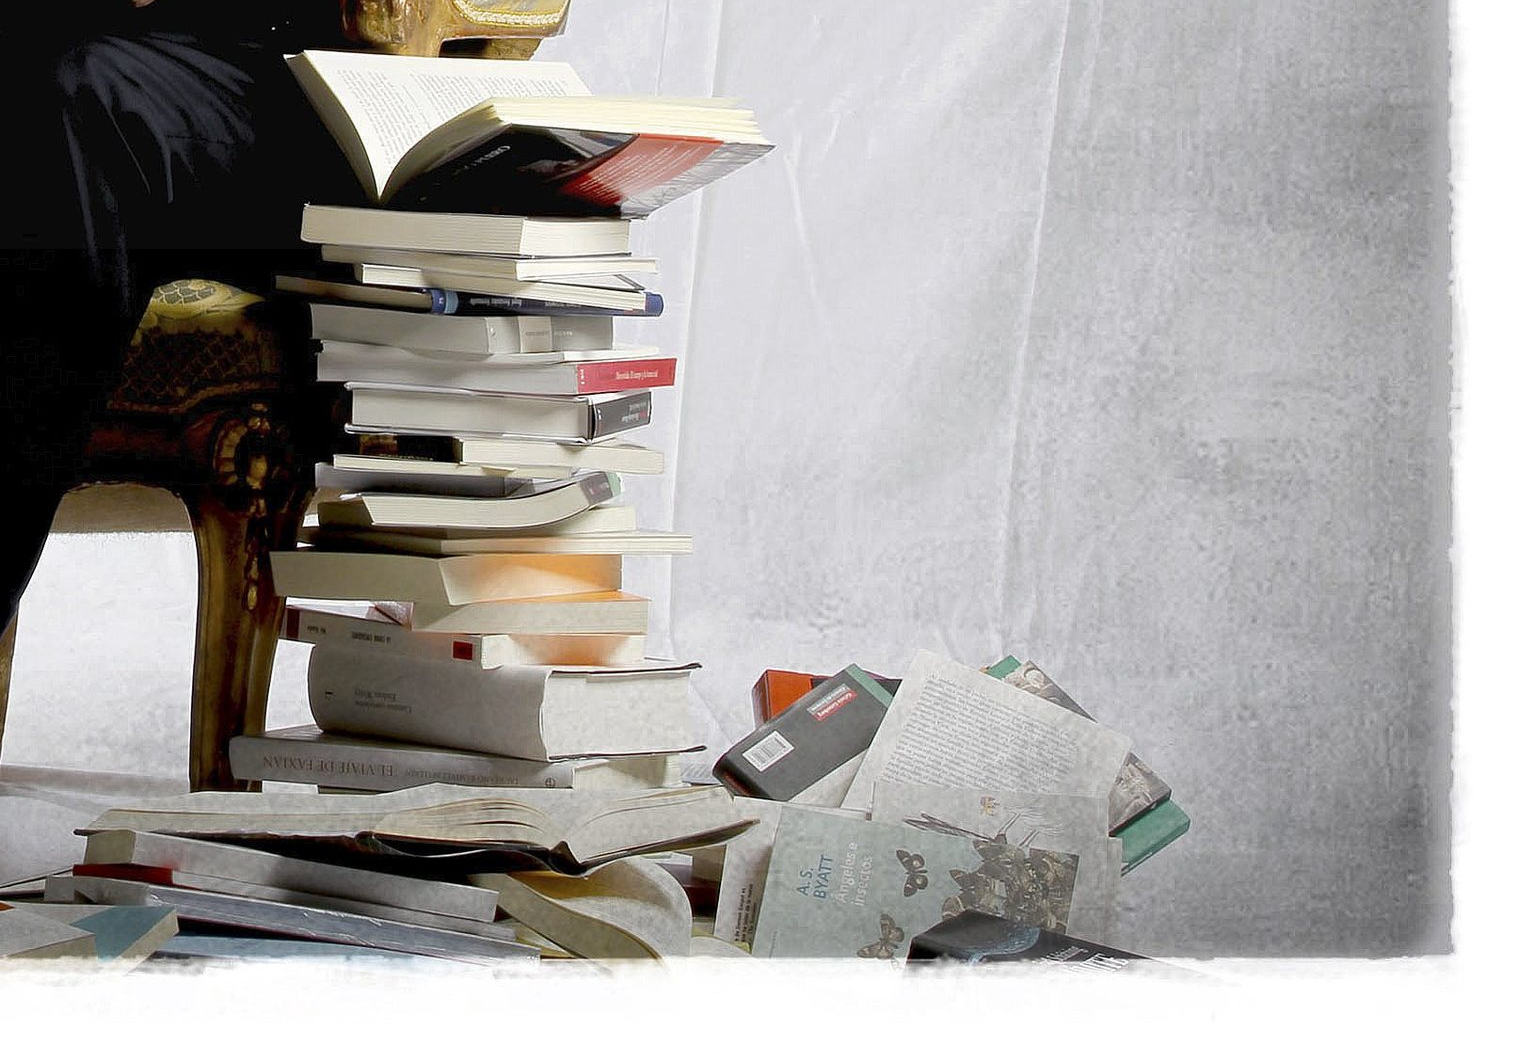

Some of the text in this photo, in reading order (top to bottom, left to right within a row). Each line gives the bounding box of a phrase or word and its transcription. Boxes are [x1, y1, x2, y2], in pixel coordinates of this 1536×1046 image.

[264, 755, 394, 777] EL VIAJE DE FAXIAN
[849, 841, 858, 850] e
[813, 854, 834, 899] BYATT
[850, 855, 873, 907] insectos
